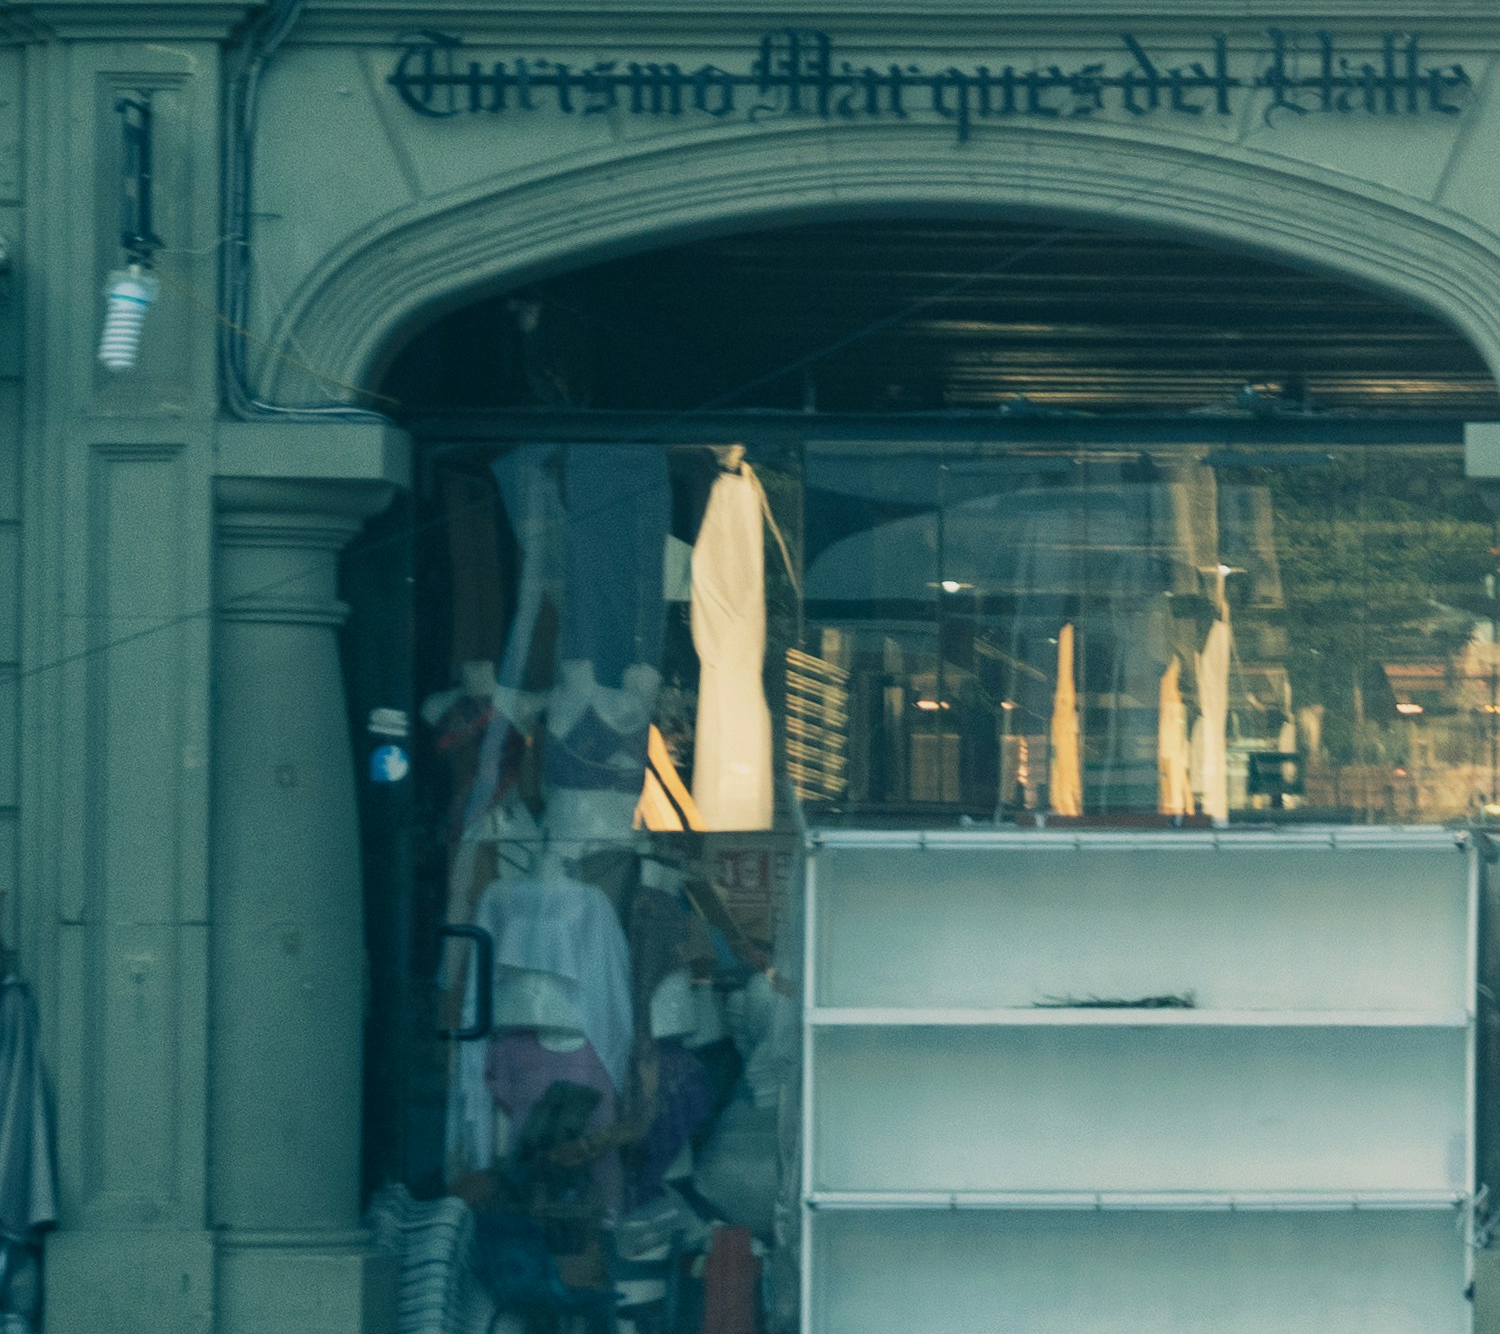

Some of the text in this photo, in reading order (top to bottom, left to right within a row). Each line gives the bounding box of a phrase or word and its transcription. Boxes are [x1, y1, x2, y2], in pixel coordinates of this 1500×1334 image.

[390, 29, 737, 119] Turismo
[1121, 31, 1236, 117] del
[1262, 27, 1474, 129] Valle
